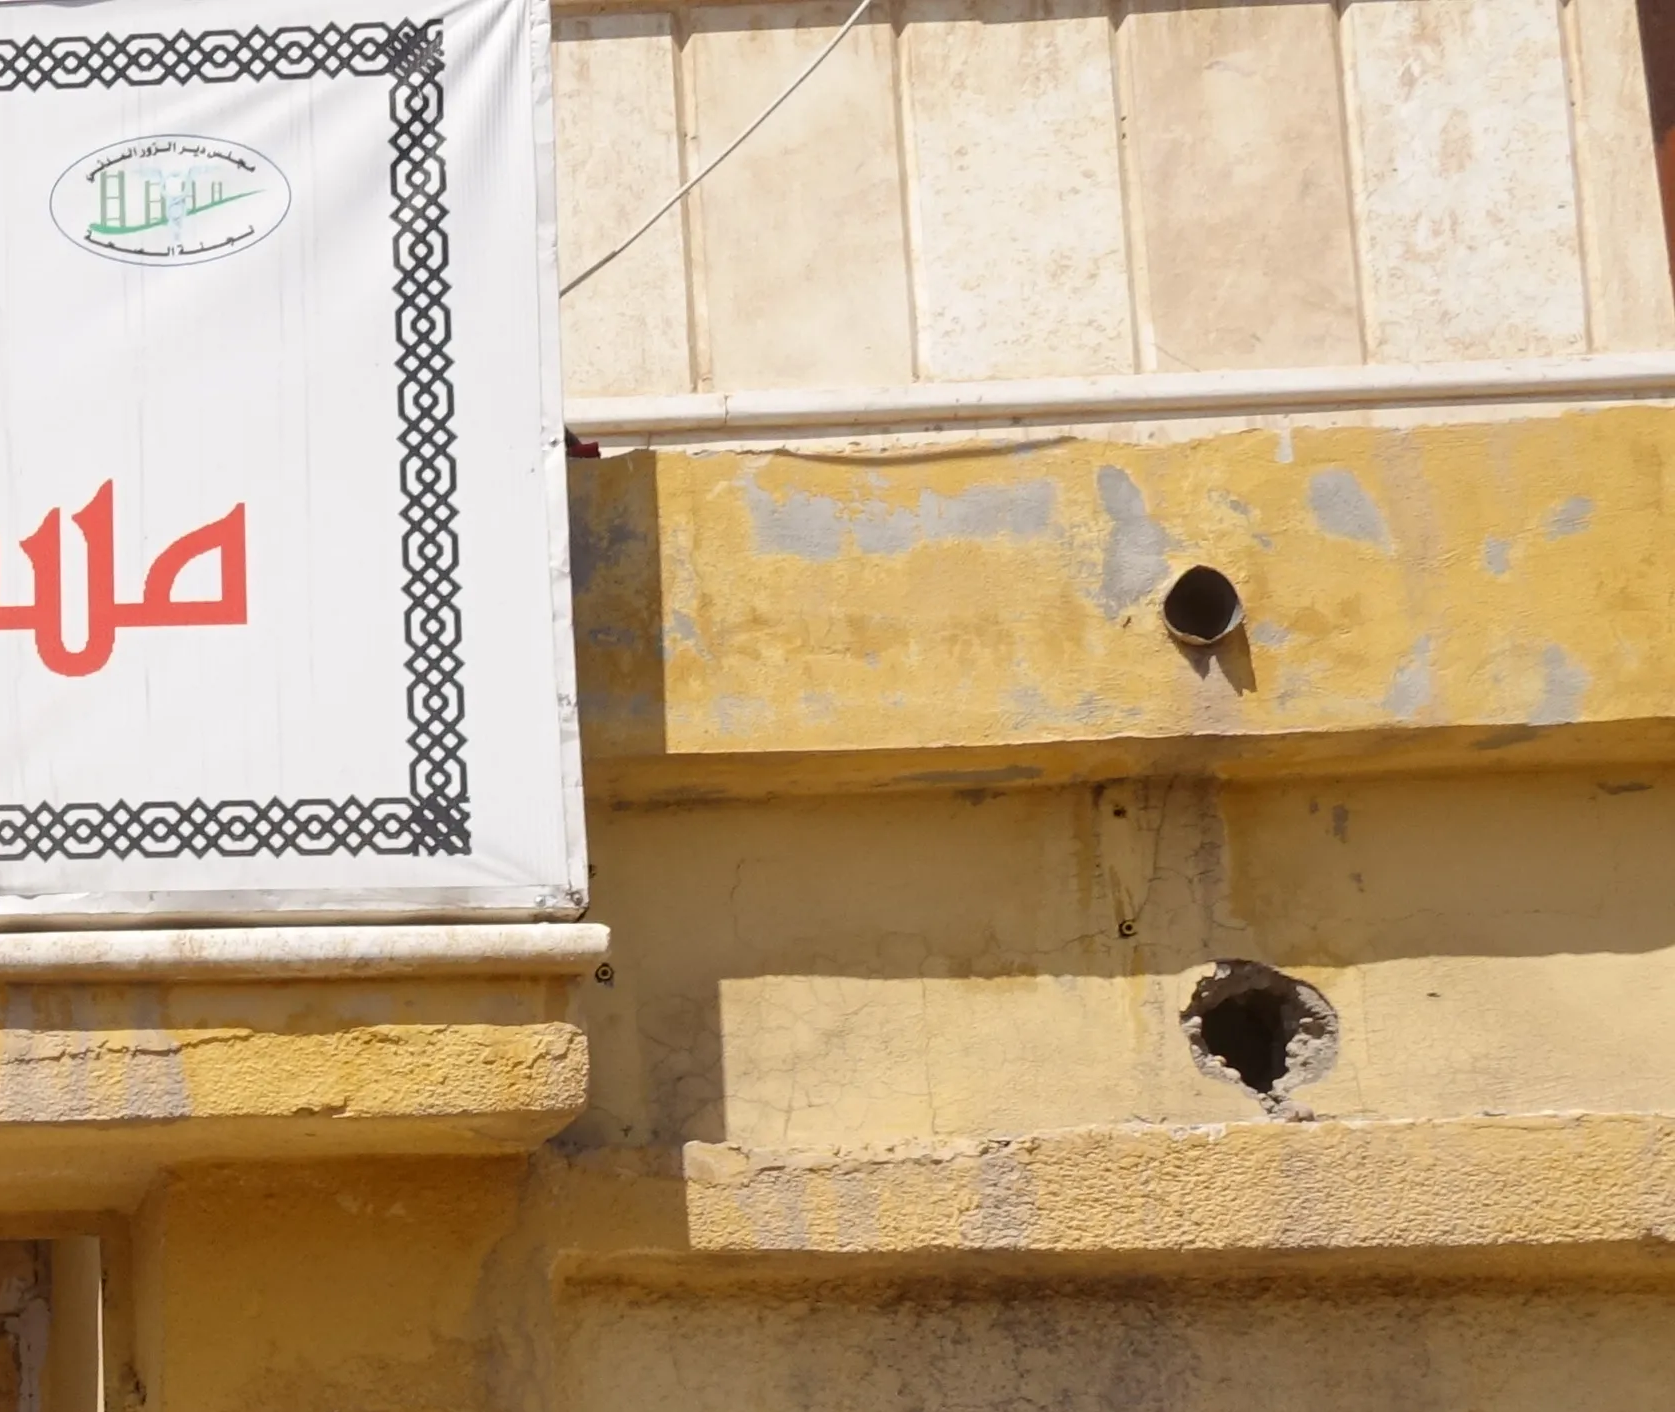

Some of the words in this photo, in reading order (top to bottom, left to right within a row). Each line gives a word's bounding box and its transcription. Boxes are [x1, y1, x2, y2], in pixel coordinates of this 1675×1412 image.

[179, 144, 206, 155] دير
[206, 151, 256, 173] مجلس
[86, 147, 138, 183] المدني
[84, 229, 175, 257] الصحة
[176, 224, 255, 255] لجنة
